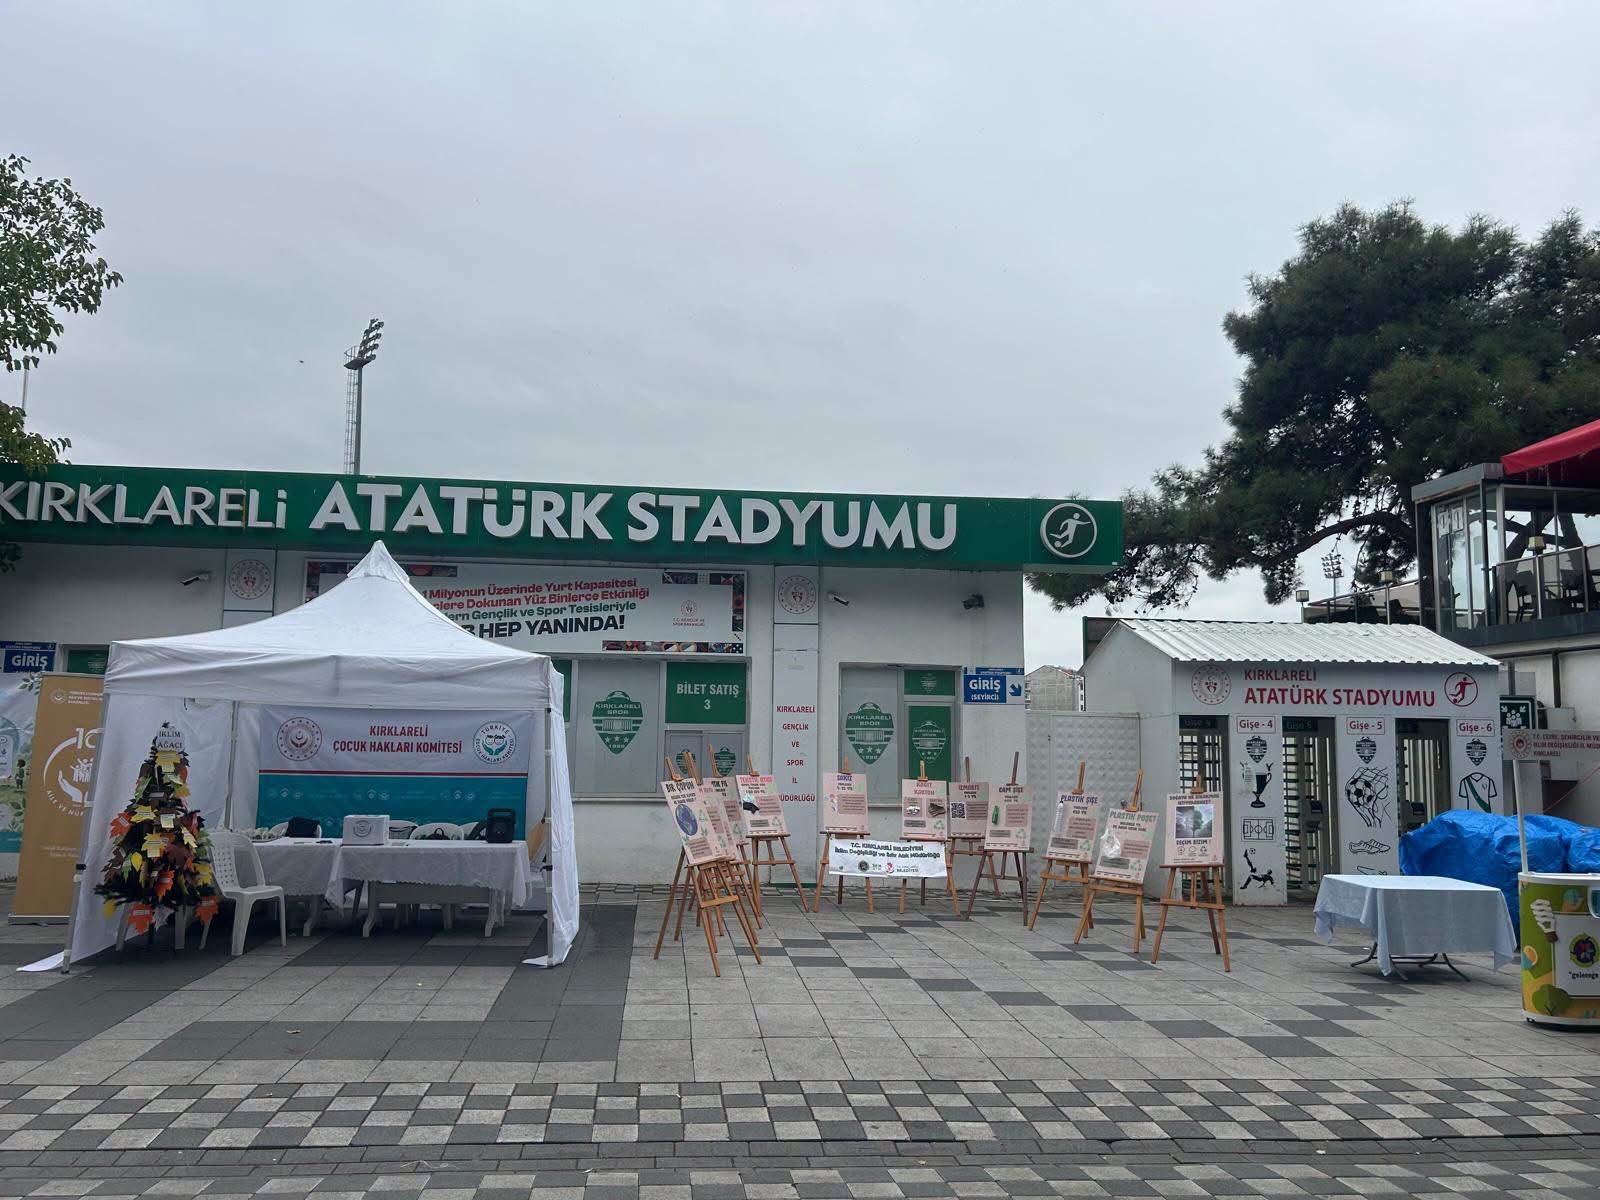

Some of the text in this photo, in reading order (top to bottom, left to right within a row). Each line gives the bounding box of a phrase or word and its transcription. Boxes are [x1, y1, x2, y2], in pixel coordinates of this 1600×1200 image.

[309, 480, 613, 541] ATATÜRK
[627, 491, 958, 551] STADYUMU
[429, 588, 486, 602] Milyonun
[487, 583, 543, 597] Üzerinde
[544, 581, 573, 594] Yurt
[574, 577, 637, 593] Kapasitesi
[466, 597, 517, 610] Dokunan
[524, 594, 546, 606] Yüz
[548, 589, 600, 605] Binlerce
[601, 586, 650, 602] Etkinliği
[471, 609, 518, 622] Gençlik
[520, 608, 534, 617] ve
[536, 605, 567, 618] Spor
[568, 602, 636, 616] Tesisleriyle
[478, 621, 522, 639] HEP
[525, 615, 626, 637] YANINDA!
[11, 652, 49, 670] GİRİŞ
[676, 681, 740, 698] BİLET SATIŞ
[969, 677, 1001, 692] GİRİŞ
[971, 692, 999, 701] (SEYİRCİ)
[1244, 684, 1436, 707] ATATÜRK STADYUMU
[703, 699, 712, 710] 3
[776, 705, 815, 713] KIRKLARELİ
[369, 724, 429, 737] KIRKLARELİ
[782, 722, 809, 732] GENÇLİK
[1239, 719, 1259, 730] Gişe
[1266, 719, 1273, 728] 4
[1349, 720, 1369, 731] Gişe
[1377, 721, 1383, 729] 5
[1458, 722, 1479, 733] Gişe
[1486, 723, 1492, 732] 6
[332, 738, 462, 755] ÇOCUK HAKLARI KOMİTESİ
[792, 776, 798, 784] İL
[779, 793, 816, 802] ÜDÜRLÜĞÜ
